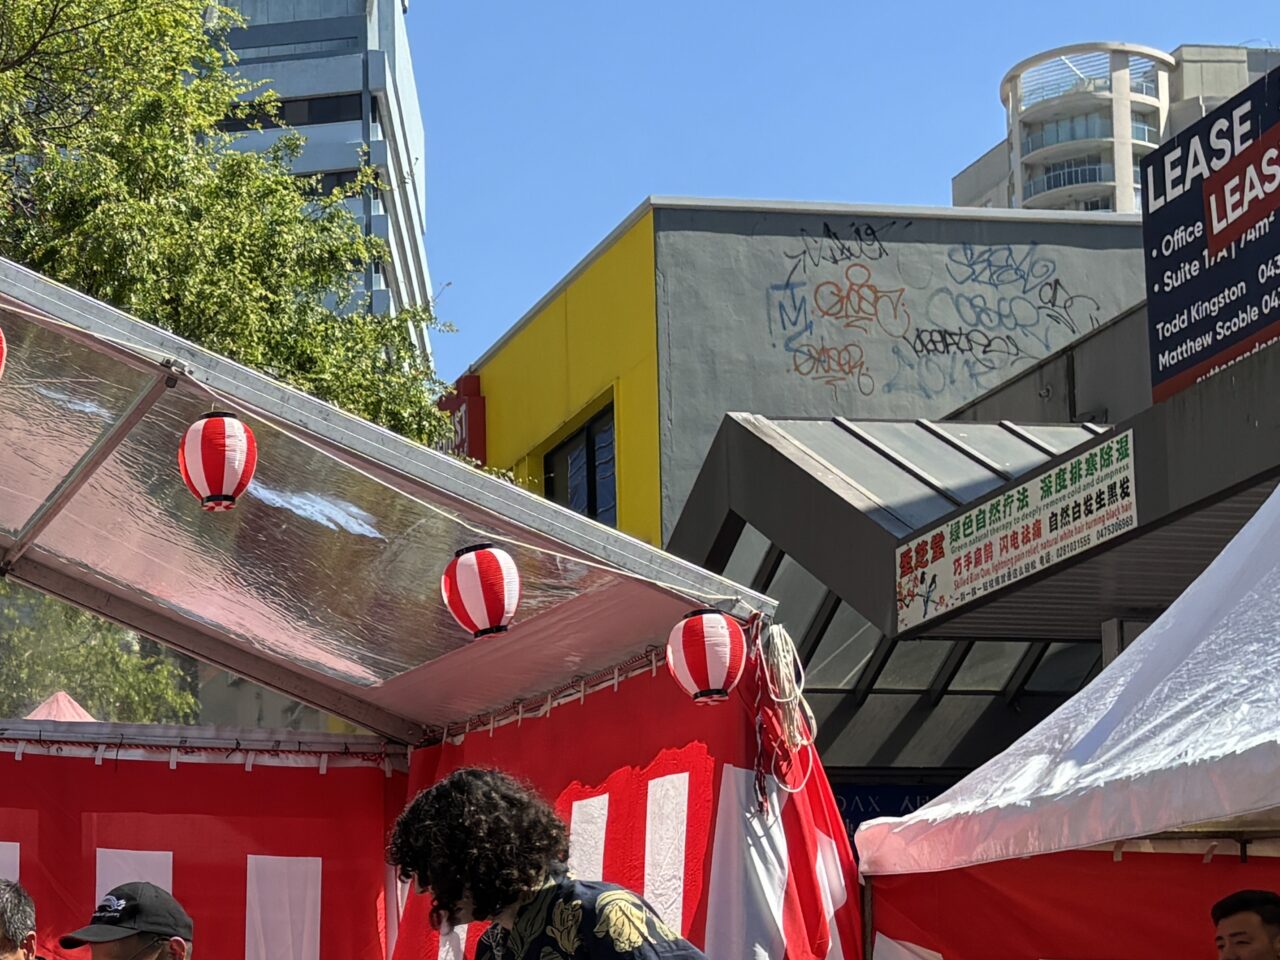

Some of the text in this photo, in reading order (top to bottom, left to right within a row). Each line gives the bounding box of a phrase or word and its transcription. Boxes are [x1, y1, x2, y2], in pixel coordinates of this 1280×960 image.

[1147, 100, 1253, 214] LEASE
[1210, 148, 1280, 235] LEAS
[1162, 221, 1203, 256] Office
[1156, 309, 1188, 340] Todd
[1190, 281, 1246, 323] Kingston
[1164, 260, 1200, 292] Suite
[1158, 331, 1212, 371] Matthew
[1216, 305, 1259, 340] Scoble
[1262, 287, 1280, 314] 04
[949, 434, 1130, 546] 绿色自然疗法 深度排寒除湿
[990, 521, 1012, 537] therapy
[1022, 504, 1041, 521] deeply
[1043, 494, 1066, 510] remove
[1067, 486, 1080, 499] cold
[1082, 479, 1095, 491] and
[1096, 463, 1130, 485] dampness
[1048, 476, 1130, 534] 自然白发生黑发
